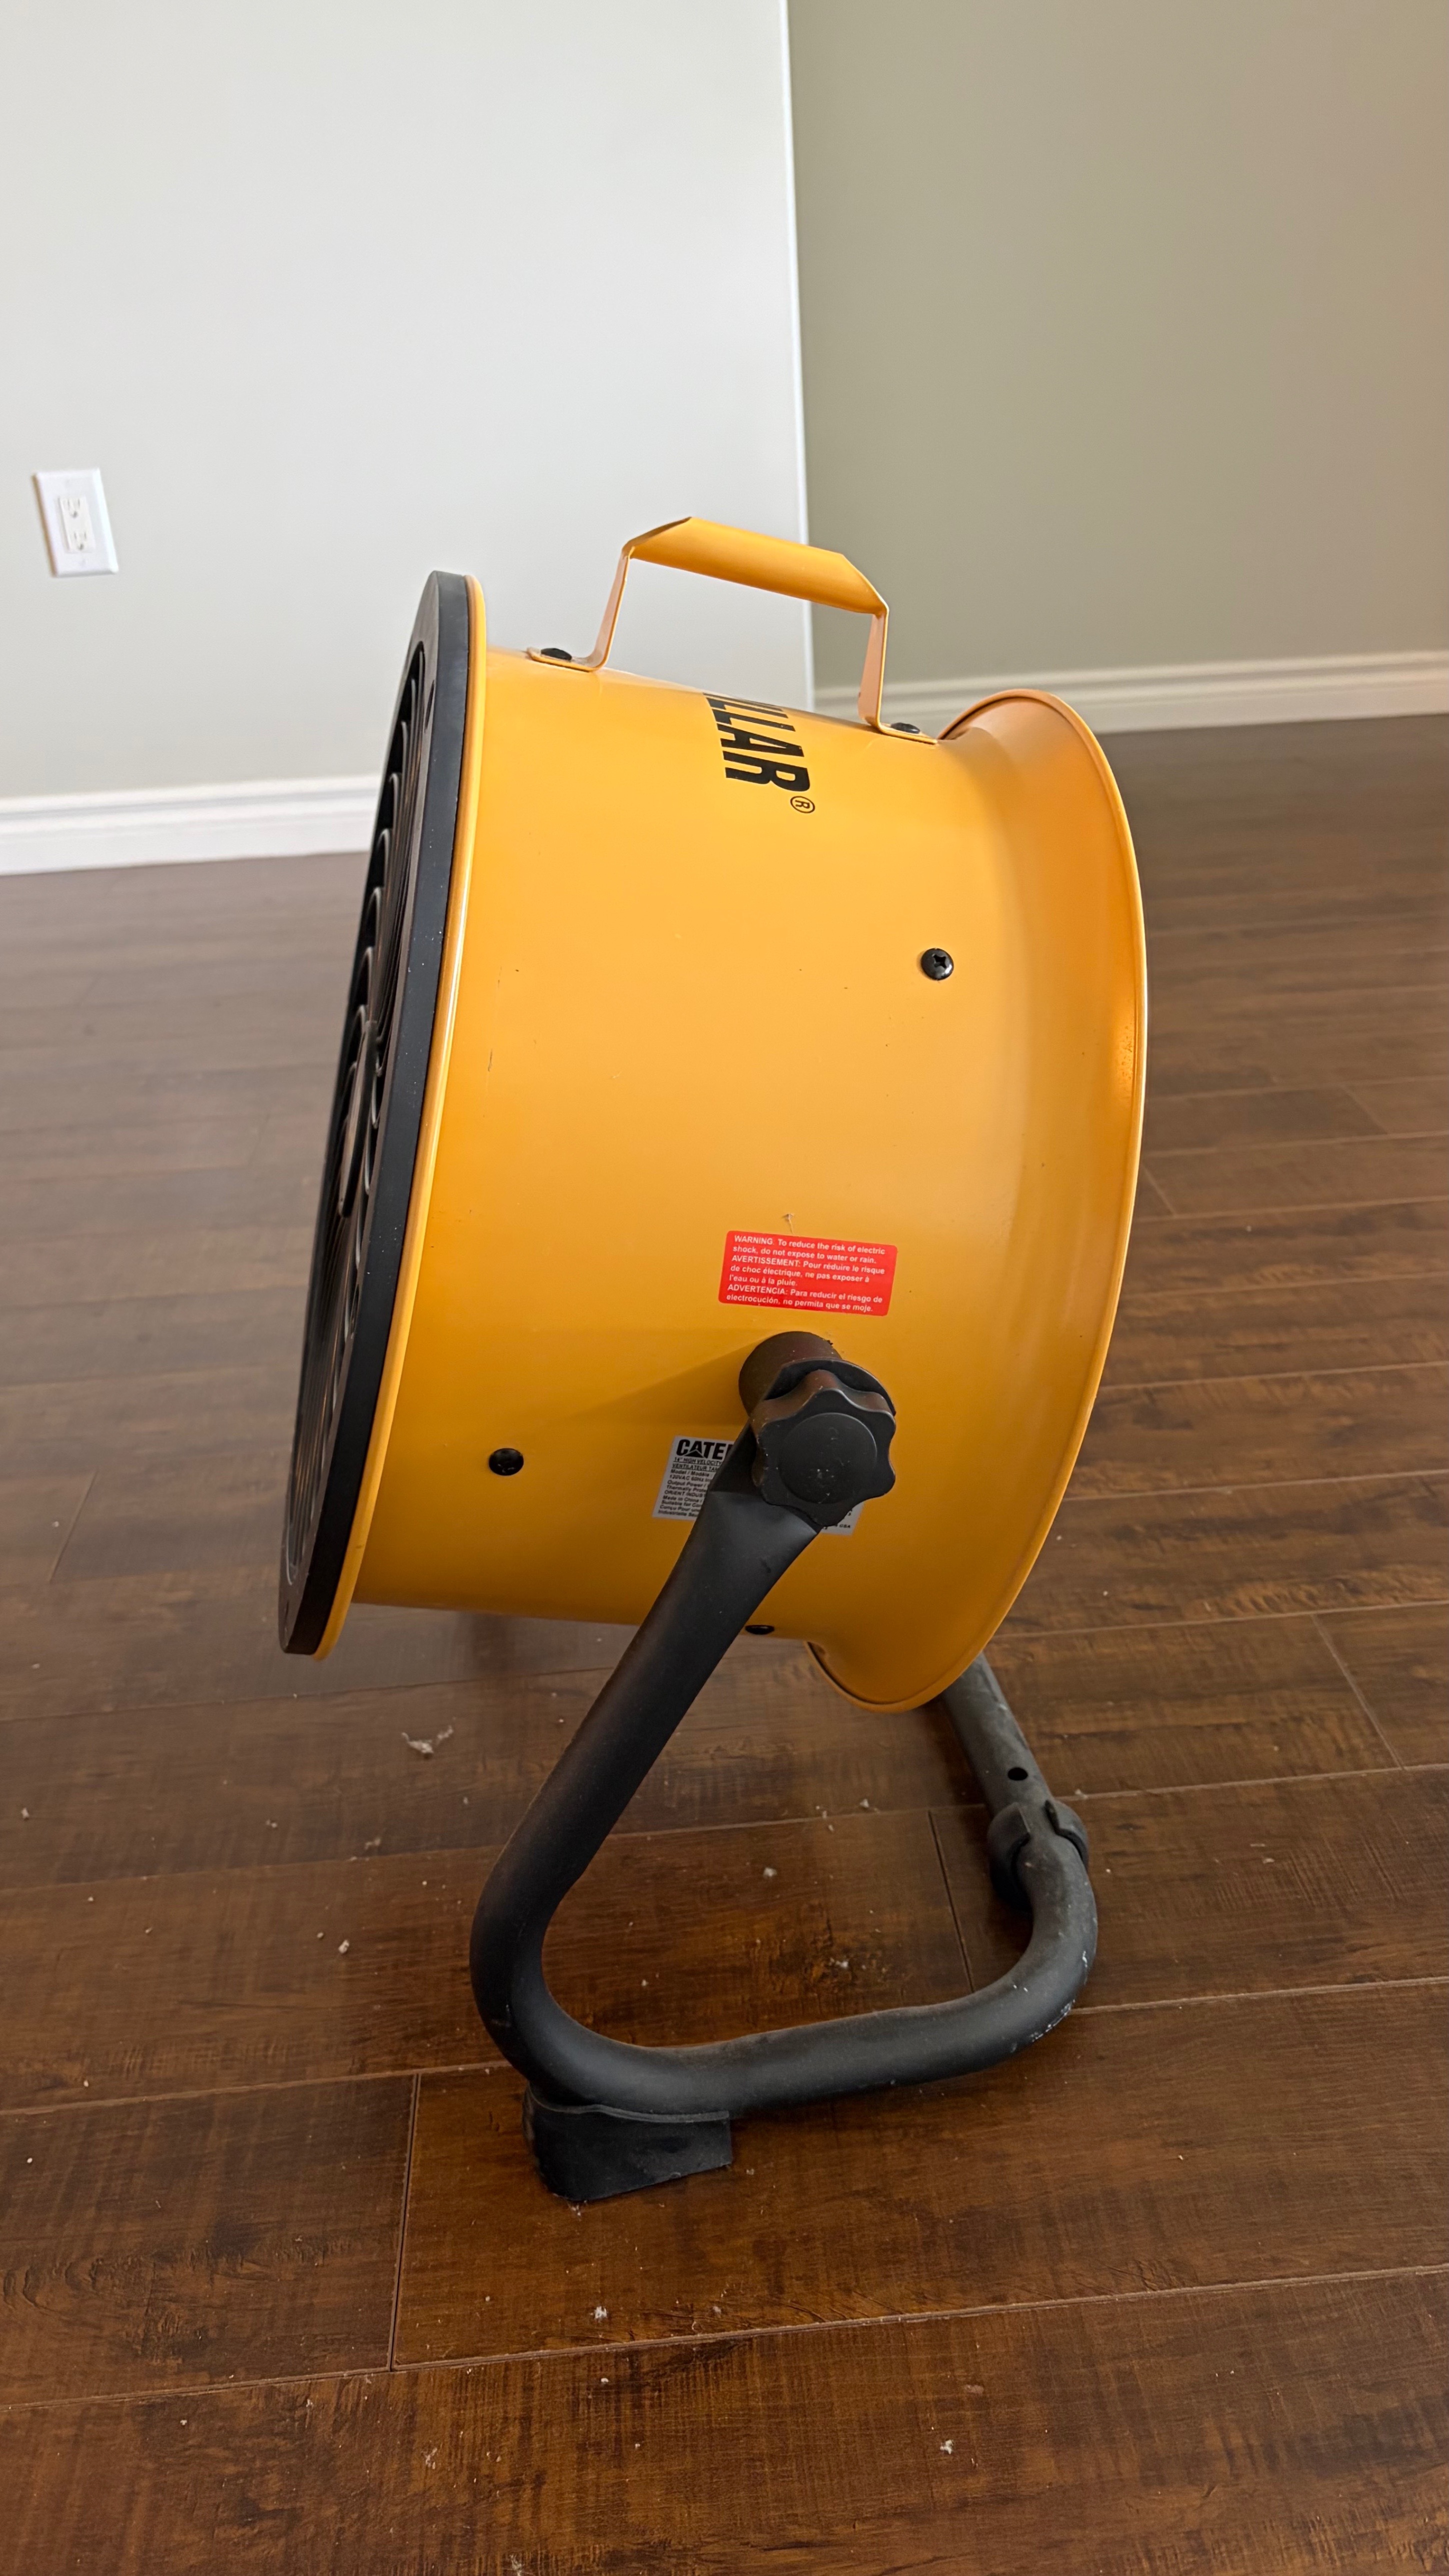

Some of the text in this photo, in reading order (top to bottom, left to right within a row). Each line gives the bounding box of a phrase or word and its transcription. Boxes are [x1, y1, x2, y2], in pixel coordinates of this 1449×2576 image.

[732, 1255, 801, 1267] AVERTISSEMENT:
[861, 1267, 885, 1275] risque
[727, 1284, 788, 1295] ADVERTENCIA:
[847, 1294, 871, 1303] riesgo
[676, 1439, 733, 1460] CATE
